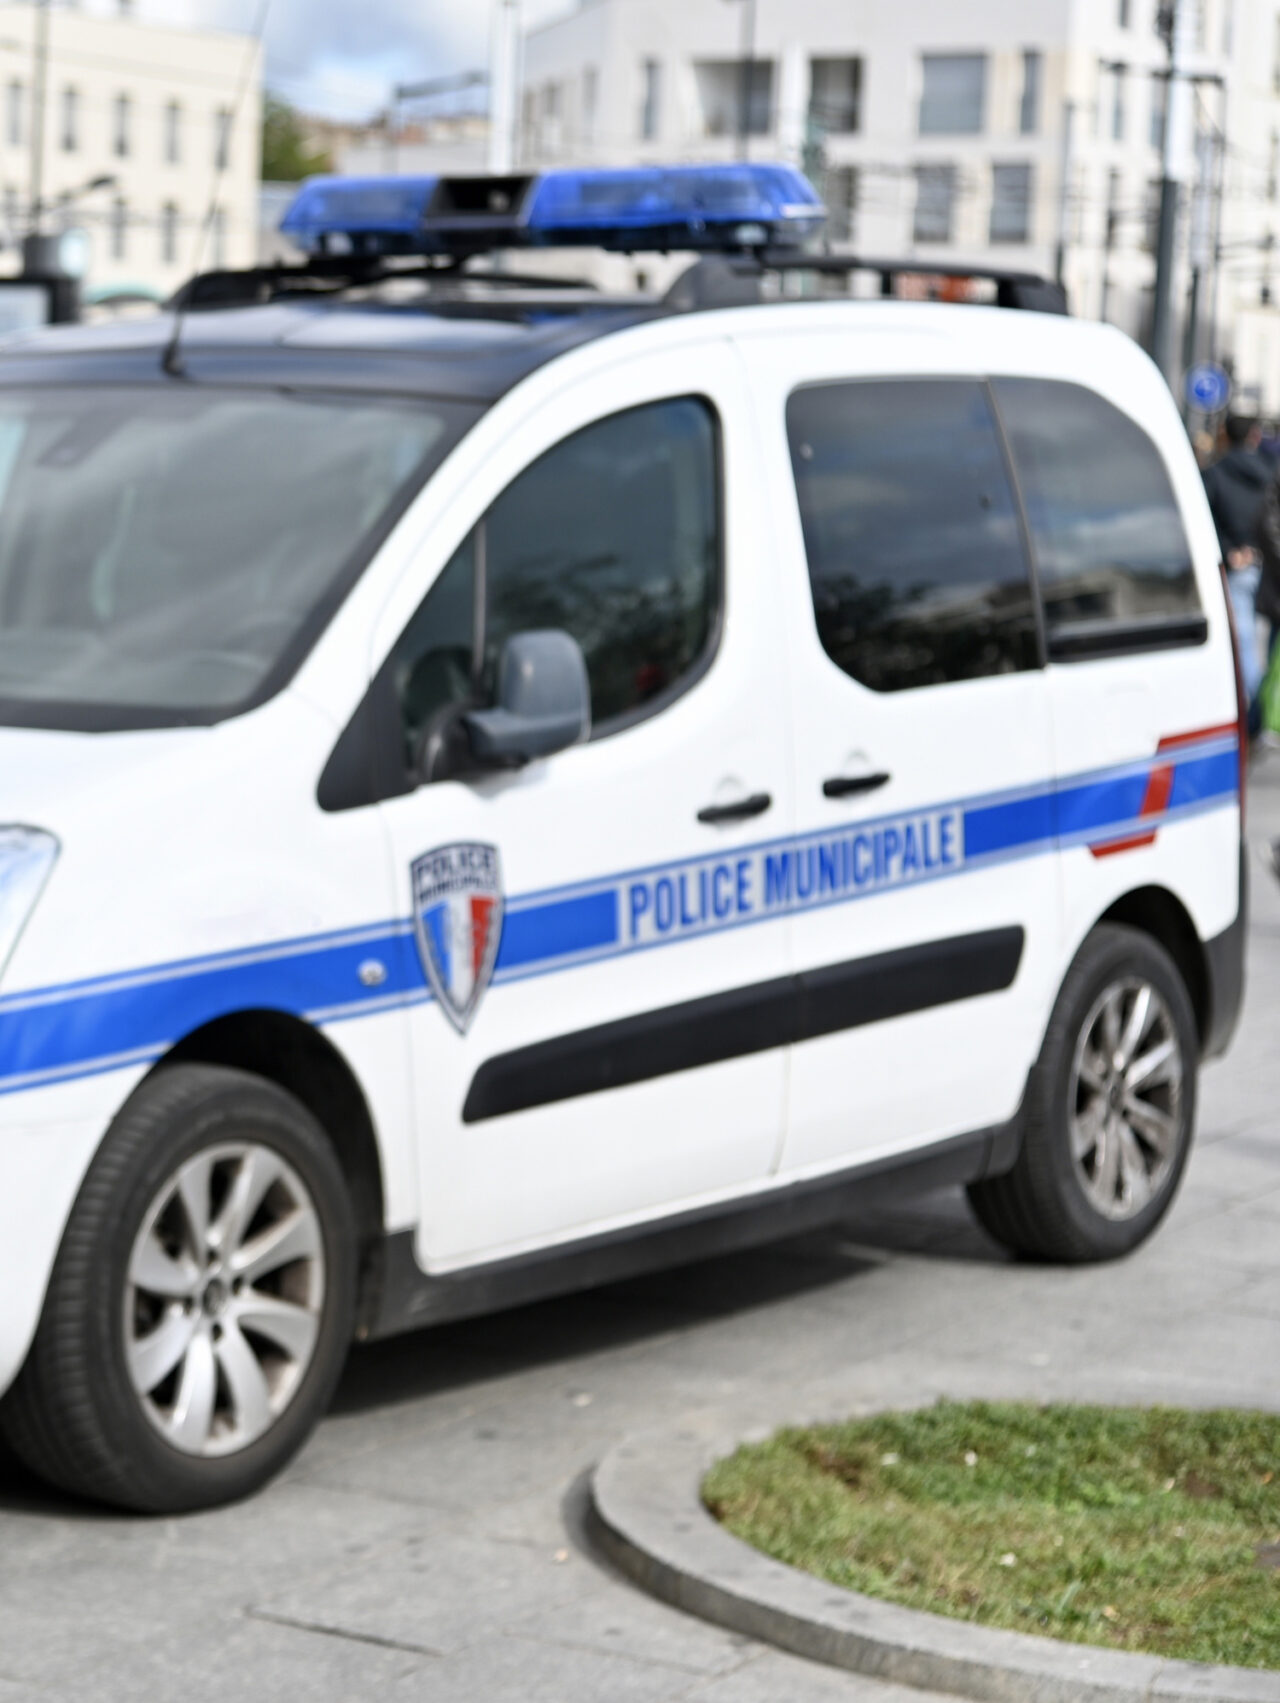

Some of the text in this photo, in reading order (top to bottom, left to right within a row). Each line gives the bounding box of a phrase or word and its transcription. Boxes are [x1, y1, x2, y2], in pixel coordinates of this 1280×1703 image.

[417, 850, 491, 881] POLICE
[630, 814, 955, 940] POLICE MUNICIPALE
